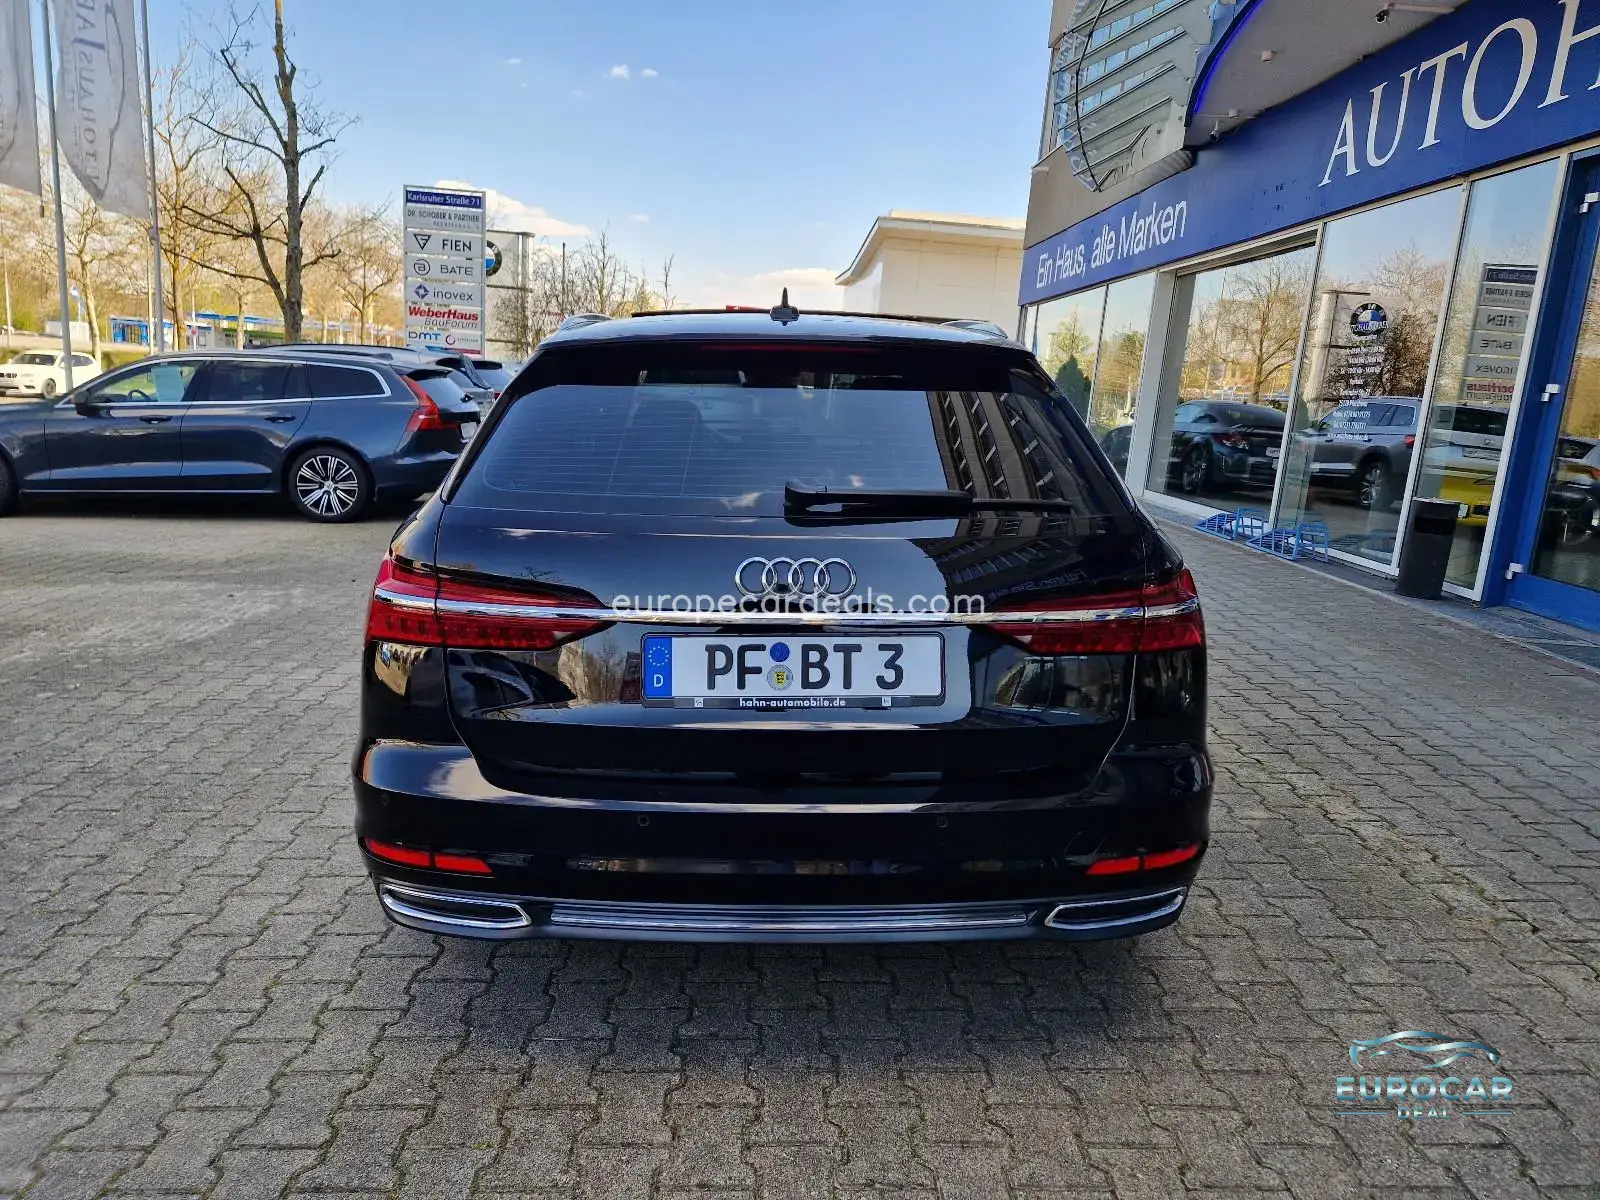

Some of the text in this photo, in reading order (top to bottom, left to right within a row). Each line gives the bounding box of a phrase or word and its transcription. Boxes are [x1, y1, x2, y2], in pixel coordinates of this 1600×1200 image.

[407, 192, 444, 203] Karlsruher
[446, 197, 470, 206] Straße
[419, 211, 447, 220] SCHOBER
[454, 214, 480, 223] PARTNER
[442, 239, 472, 252] FIEN
[1036, 200, 1187, 289] Ein Haus, alle Marken
[440, 265, 474, 276] BATE
[433, 288, 474, 301] inovex
[408, 306, 479, 321] WeberHaus
[424, 318, 478, 329] BauForum
[408, 331, 441, 341] DMT
[704, 644, 904, 690] PF BT 3
[653, 674, 664, 687] D
[739, 697, 846, 708] hahn-automobile.de
